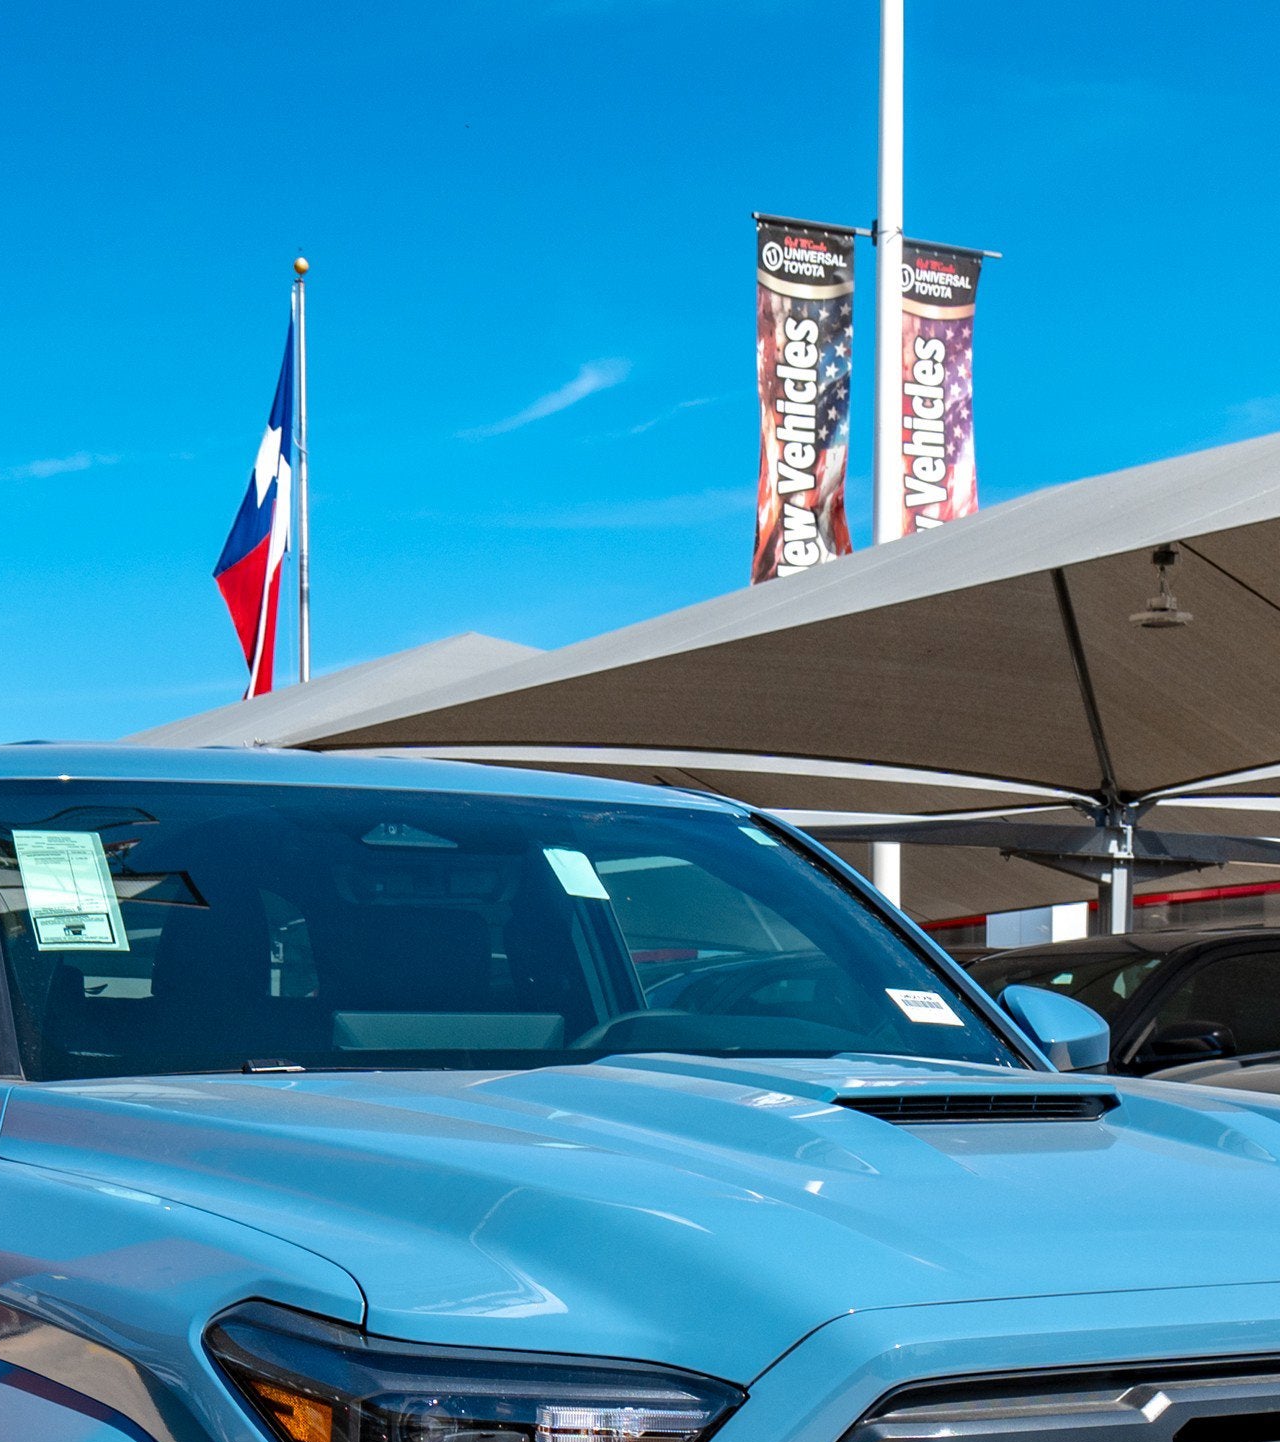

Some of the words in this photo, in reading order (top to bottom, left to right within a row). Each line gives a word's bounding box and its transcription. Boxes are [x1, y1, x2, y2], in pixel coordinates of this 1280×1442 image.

[784, 246, 847, 268] UNIVERSAL
[783, 260, 825, 278] TOYOTA
[915, 268, 972, 289] UNIVERSAL
[915, 281, 952, 299] TOYOTA
[776, 316, 820, 495] Vehicles
[904, 336, 947, 507] Vehicles
